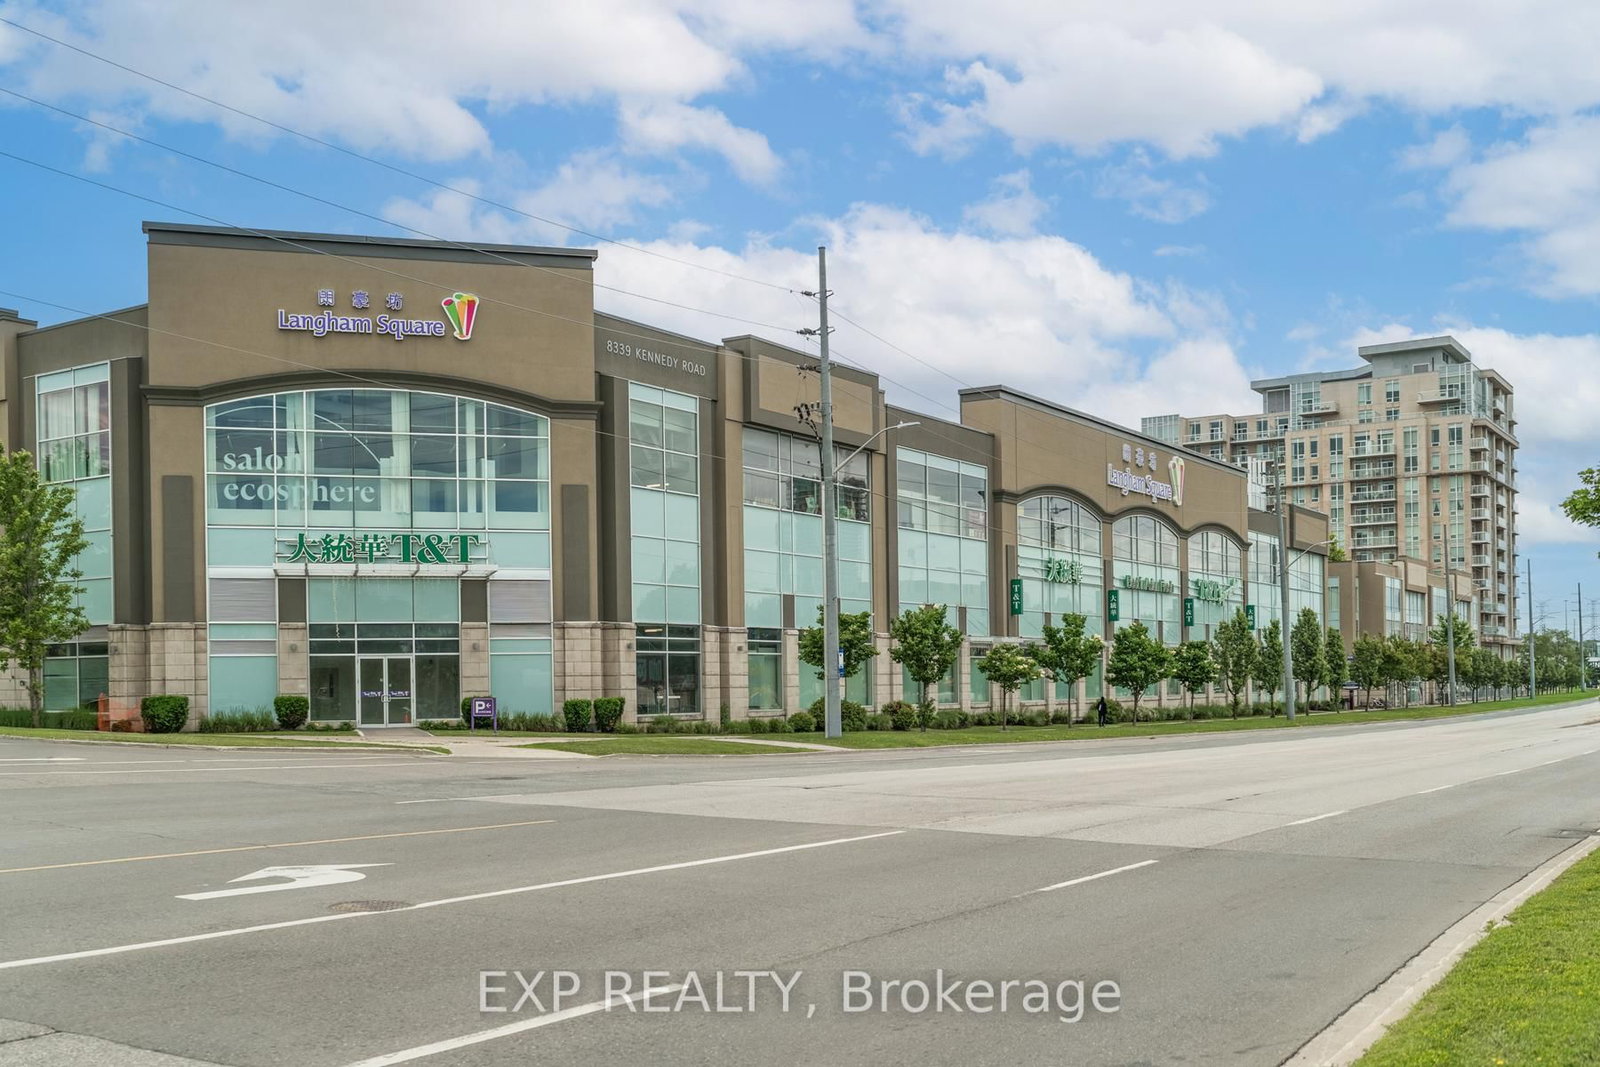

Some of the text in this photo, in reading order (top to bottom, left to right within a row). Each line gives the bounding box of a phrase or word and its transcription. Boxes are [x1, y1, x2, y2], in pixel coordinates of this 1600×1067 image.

[278, 309, 445, 341] Langham Square
[606, 340, 706, 376] 8339 KENNEDY ROAD
[223, 446, 303, 471] salon
[223, 479, 376, 508] ecosphere
[1107, 463, 1173, 503] Langham Square
[286, 533, 480, 564] 大統華 T&T
[1012, 584, 1021, 609] T&T
[1185, 602, 1193, 622] T&T
